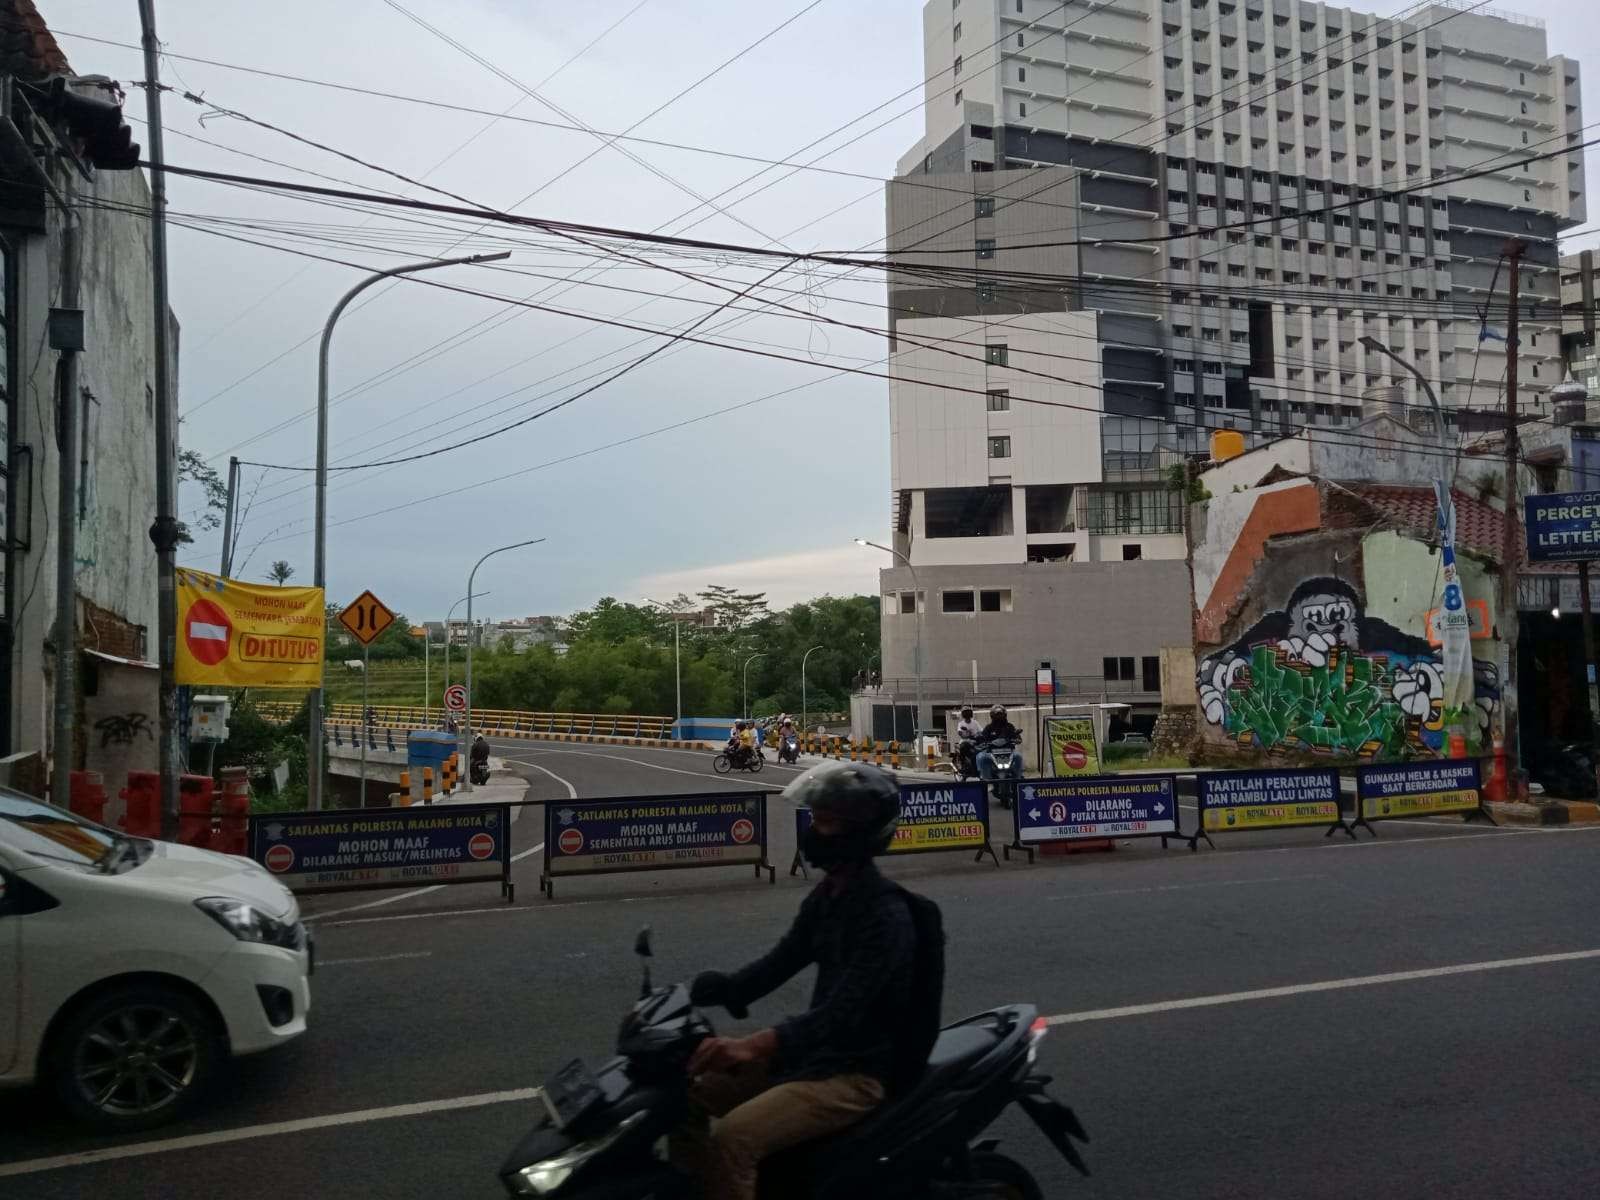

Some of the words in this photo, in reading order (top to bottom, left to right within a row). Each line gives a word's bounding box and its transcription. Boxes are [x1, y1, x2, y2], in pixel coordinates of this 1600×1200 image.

[255, 597, 286, 609] MOHON
[245, 637, 318, 659] DITUTUP
[1207, 778, 1263, 792] TAATILAH
[1266, 775, 1331, 789] PERATURAN
[1364, 772, 1406, 784] GUNAKAN
[1408, 770, 1431, 780] HELM
[1433, 770, 1439, 779] &
[1440, 767, 1473, 779] MASKER
[1036, 788, 1076, 798] SATLANTAS
[1078, 786, 1110, 796] POLRESTA
[1112, 784, 1141, 794] MALANG
[1142, 784, 1159, 793] KOTA
[1382, 783, 1404, 793] SAAT
[1405, 778, 1458, 791] BERKENDARA
[906, 789, 954, 805] JALAN
[1207, 793, 1228, 805] DAN
[1231, 792, 1267, 803] RAMBU
[1270, 790, 1296, 801] LALU
[1298, 788, 1333, 800] LINTAS
[577, 810, 629, 822] SATLANTAS
[632, 808, 676, 819] POLRESTA
[679, 804, 718, 816] MALANG
[720, 803, 743, 813] KOTA
[940, 803, 976, 815] CINTA
[1086, 799, 1132, 811] DILARANG
[1071, 812, 1096, 822] PUTAR
[1098, 811, 1119, 820] BALIK
[1121, 810, 1129, 819] DI
[1131, 809, 1148, 818] SINI
[288, 823, 349, 836] SATLANTAS
[352, 820, 404, 832] POLRESTA
[408, 817, 453, 830] MALANG
[456, 816, 481, 827] KOTA
[620, 823, 664, 837] MOHON
[667, 822, 698, 833] MAAF
[928, 827, 958, 838] ROYAL
[338, 838, 389, 853] MOHON
[394, 836, 430, 850] MAAF
[590, 838, 647, 849] SEMENTARA
[649, 835, 674, 846] ARUS
[676, 832, 726, 844] DIALIHKAN
[303, 854, 359, 867] DILARANG
[364, 847, 462, 864] MASUK/MELINTAS
